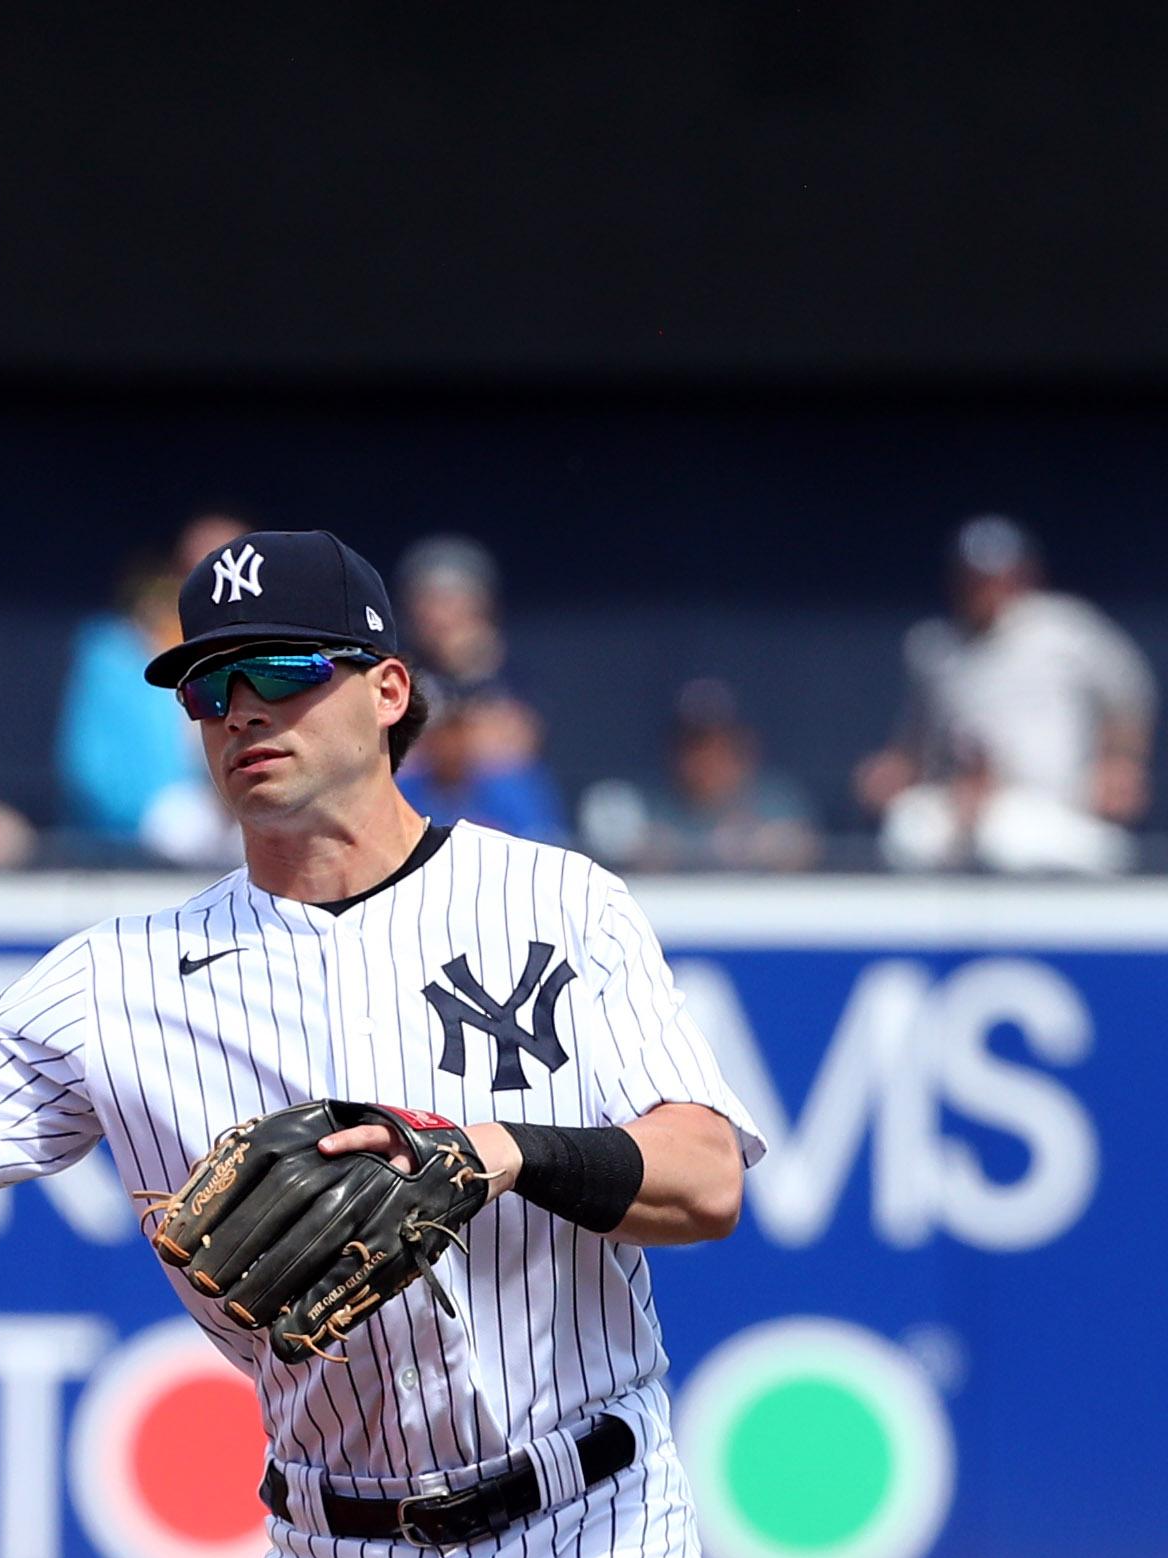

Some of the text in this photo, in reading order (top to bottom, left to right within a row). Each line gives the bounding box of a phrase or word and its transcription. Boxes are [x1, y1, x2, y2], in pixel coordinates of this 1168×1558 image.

[211, 543, 264, 604] NY
[420, 940, 578, 1092] NY
[192, 1142, 251, 1216] Rawlings
[307, 1301, 326, 1321] THE
[322, 1284, 347, 1307] GOLD
